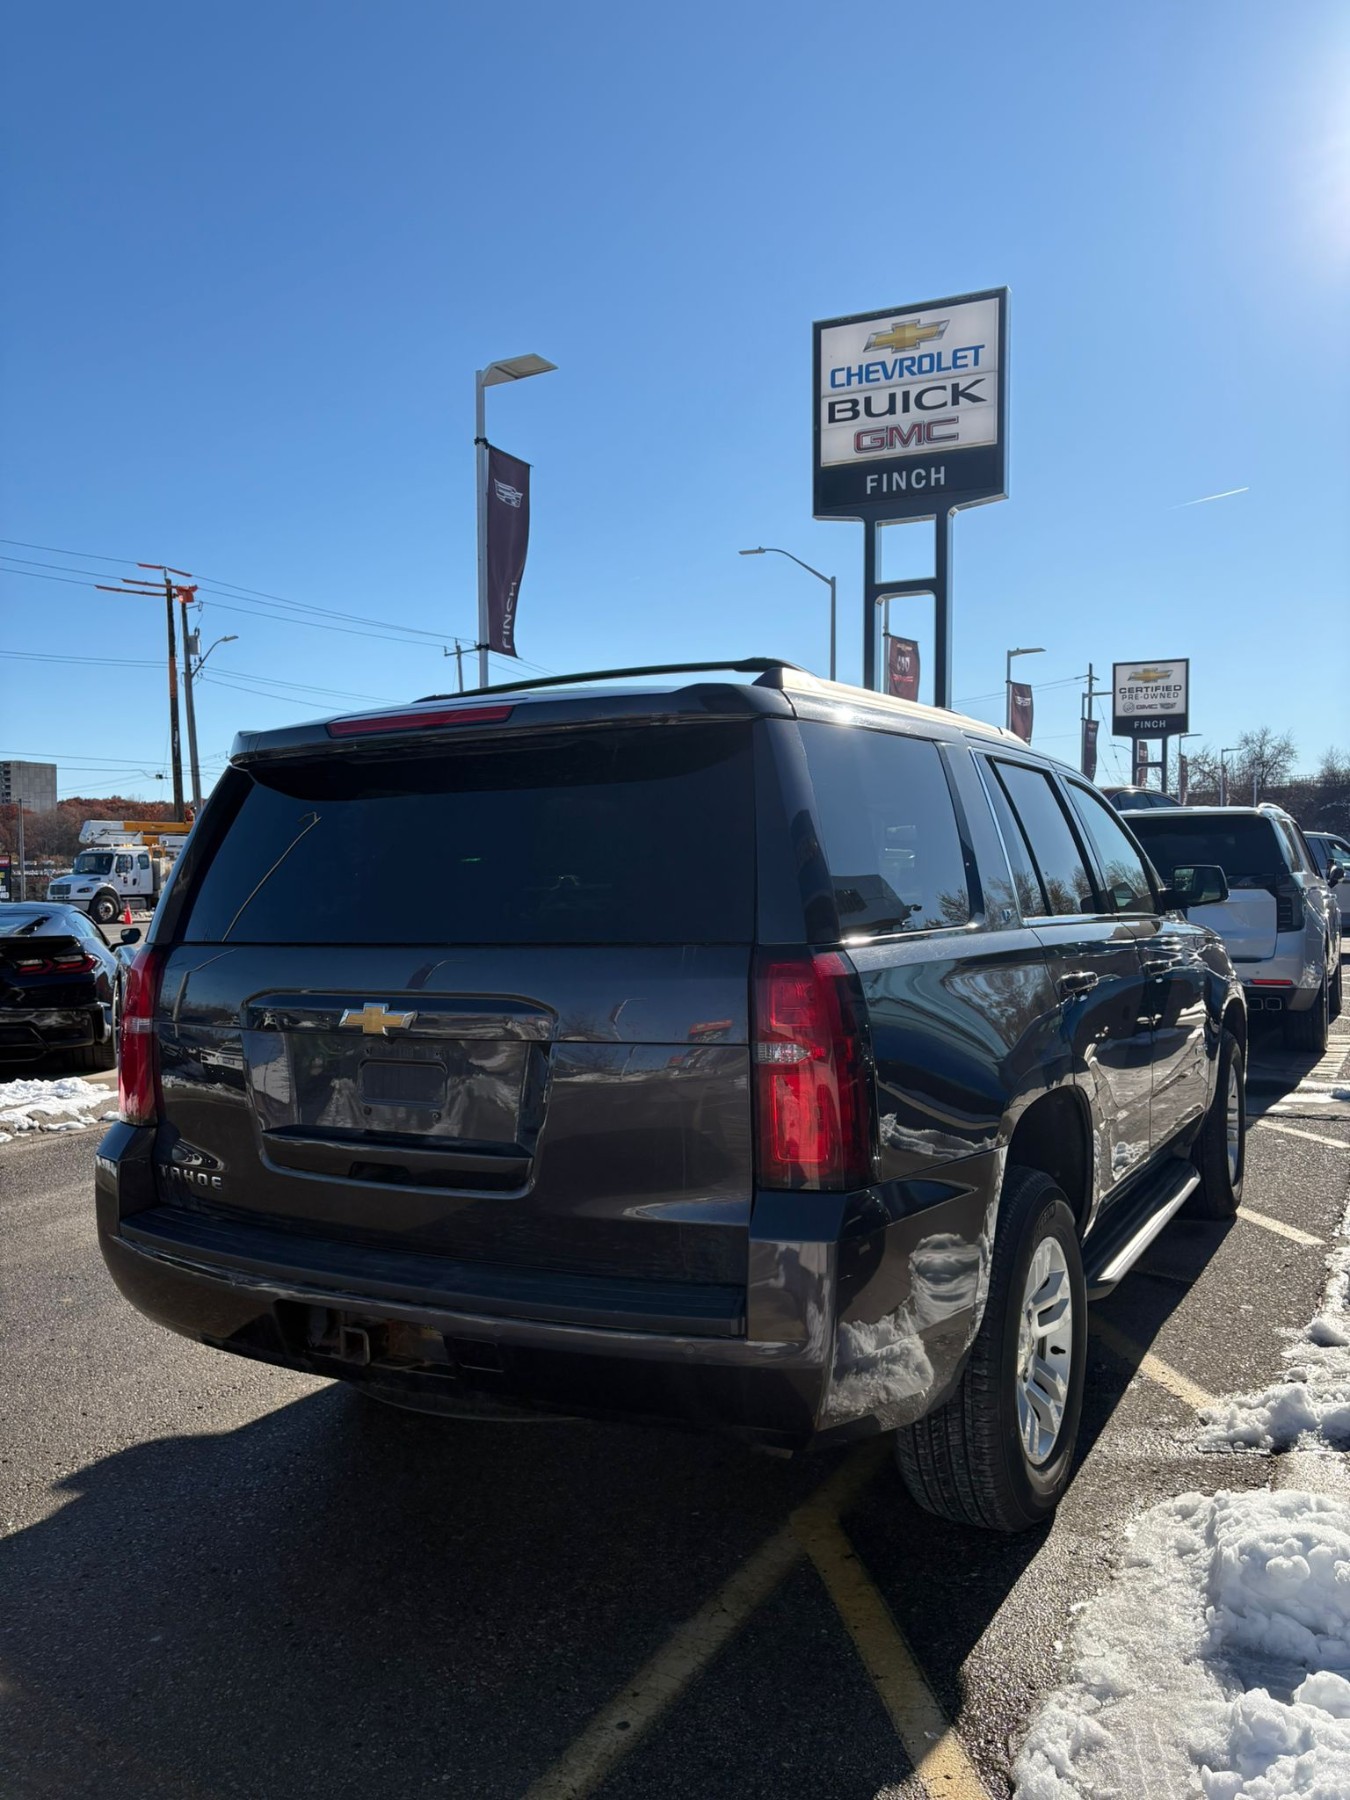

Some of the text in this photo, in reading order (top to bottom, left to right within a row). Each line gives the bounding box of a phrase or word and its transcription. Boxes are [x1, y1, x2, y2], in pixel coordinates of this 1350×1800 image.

[830, 344, 985, 389] CHEVROLET
[828, 378, 988, 424] BUICK
[854, 416, 959, 453] GMC
[866, 466, 946, 495] FINCH
[502, 582, 517, 649] FINCH
[1119, 684, 1182, 694] CERTIFIED
[1121, 692, 1179, 701] PRE-OWNED
[1134, 720, 1166, 728] FINCH
[159, 1164, 222, 1190] TAHOE
